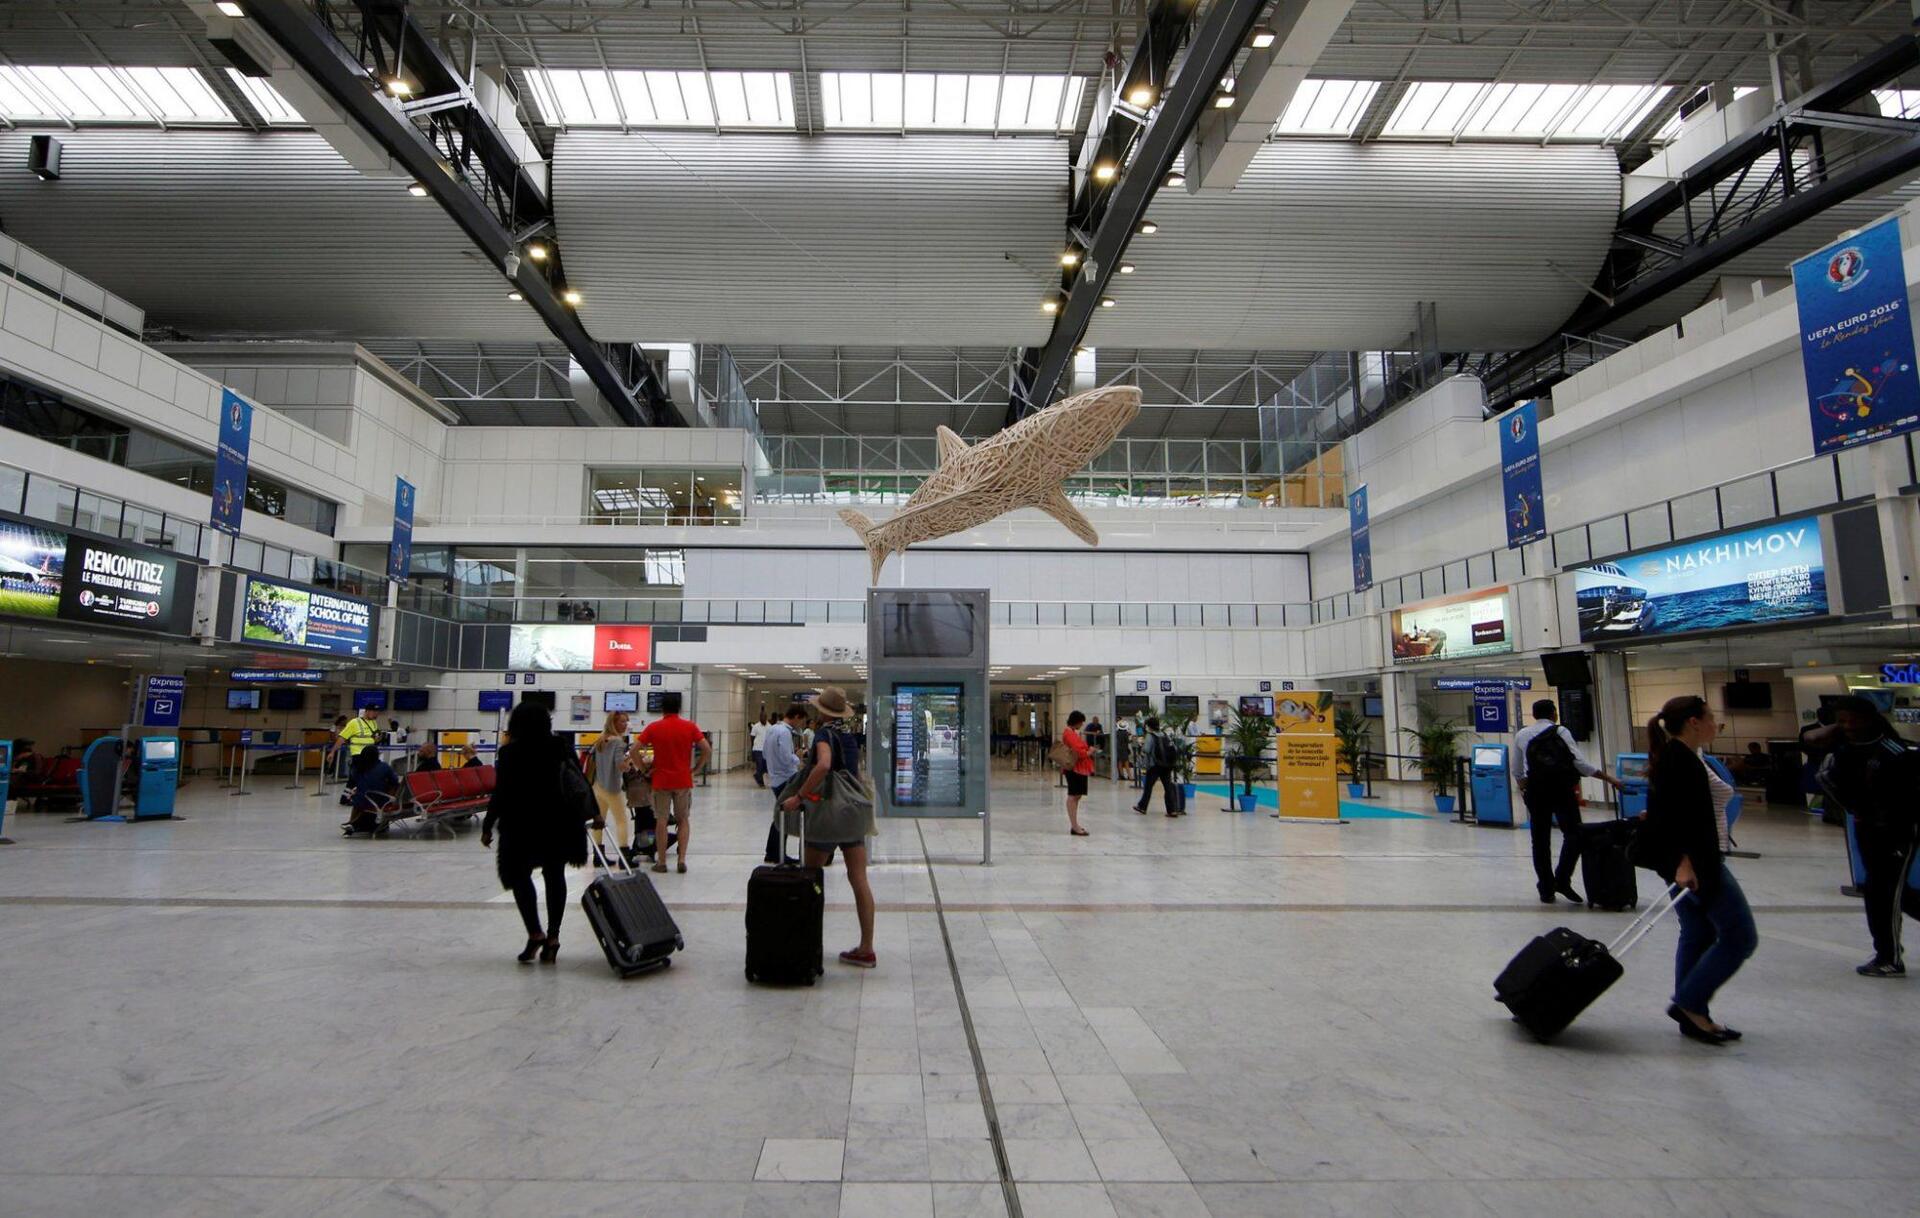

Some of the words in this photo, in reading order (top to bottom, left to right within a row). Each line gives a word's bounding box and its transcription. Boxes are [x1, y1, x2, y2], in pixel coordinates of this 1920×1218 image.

[1807, 325, 1836, 342] UEFA
[1837, 313, 1868, 331] EURO
[1869, 300, 1900, 318] 2016
[1665, 528, 1805, 573] NAKHIMOV
[83, 548, 164, 585] RENCONTREZ
[82, 571, 91, 583] LE
[91, 572, 123, 588] MEILLEUR
[123, 578, 133, 591] DE
[133, 581, 162, 596] L'EUROPE
[309, 606, 341, 622] SCHOOL
[341, 612, 353, 624] OF
[352, 614, 369, 627] NICE
[310, 593, 369, 616] INTERNATIONAL
[150, 677, 184, 687] express
[1474, 685, 1505, 694] express
